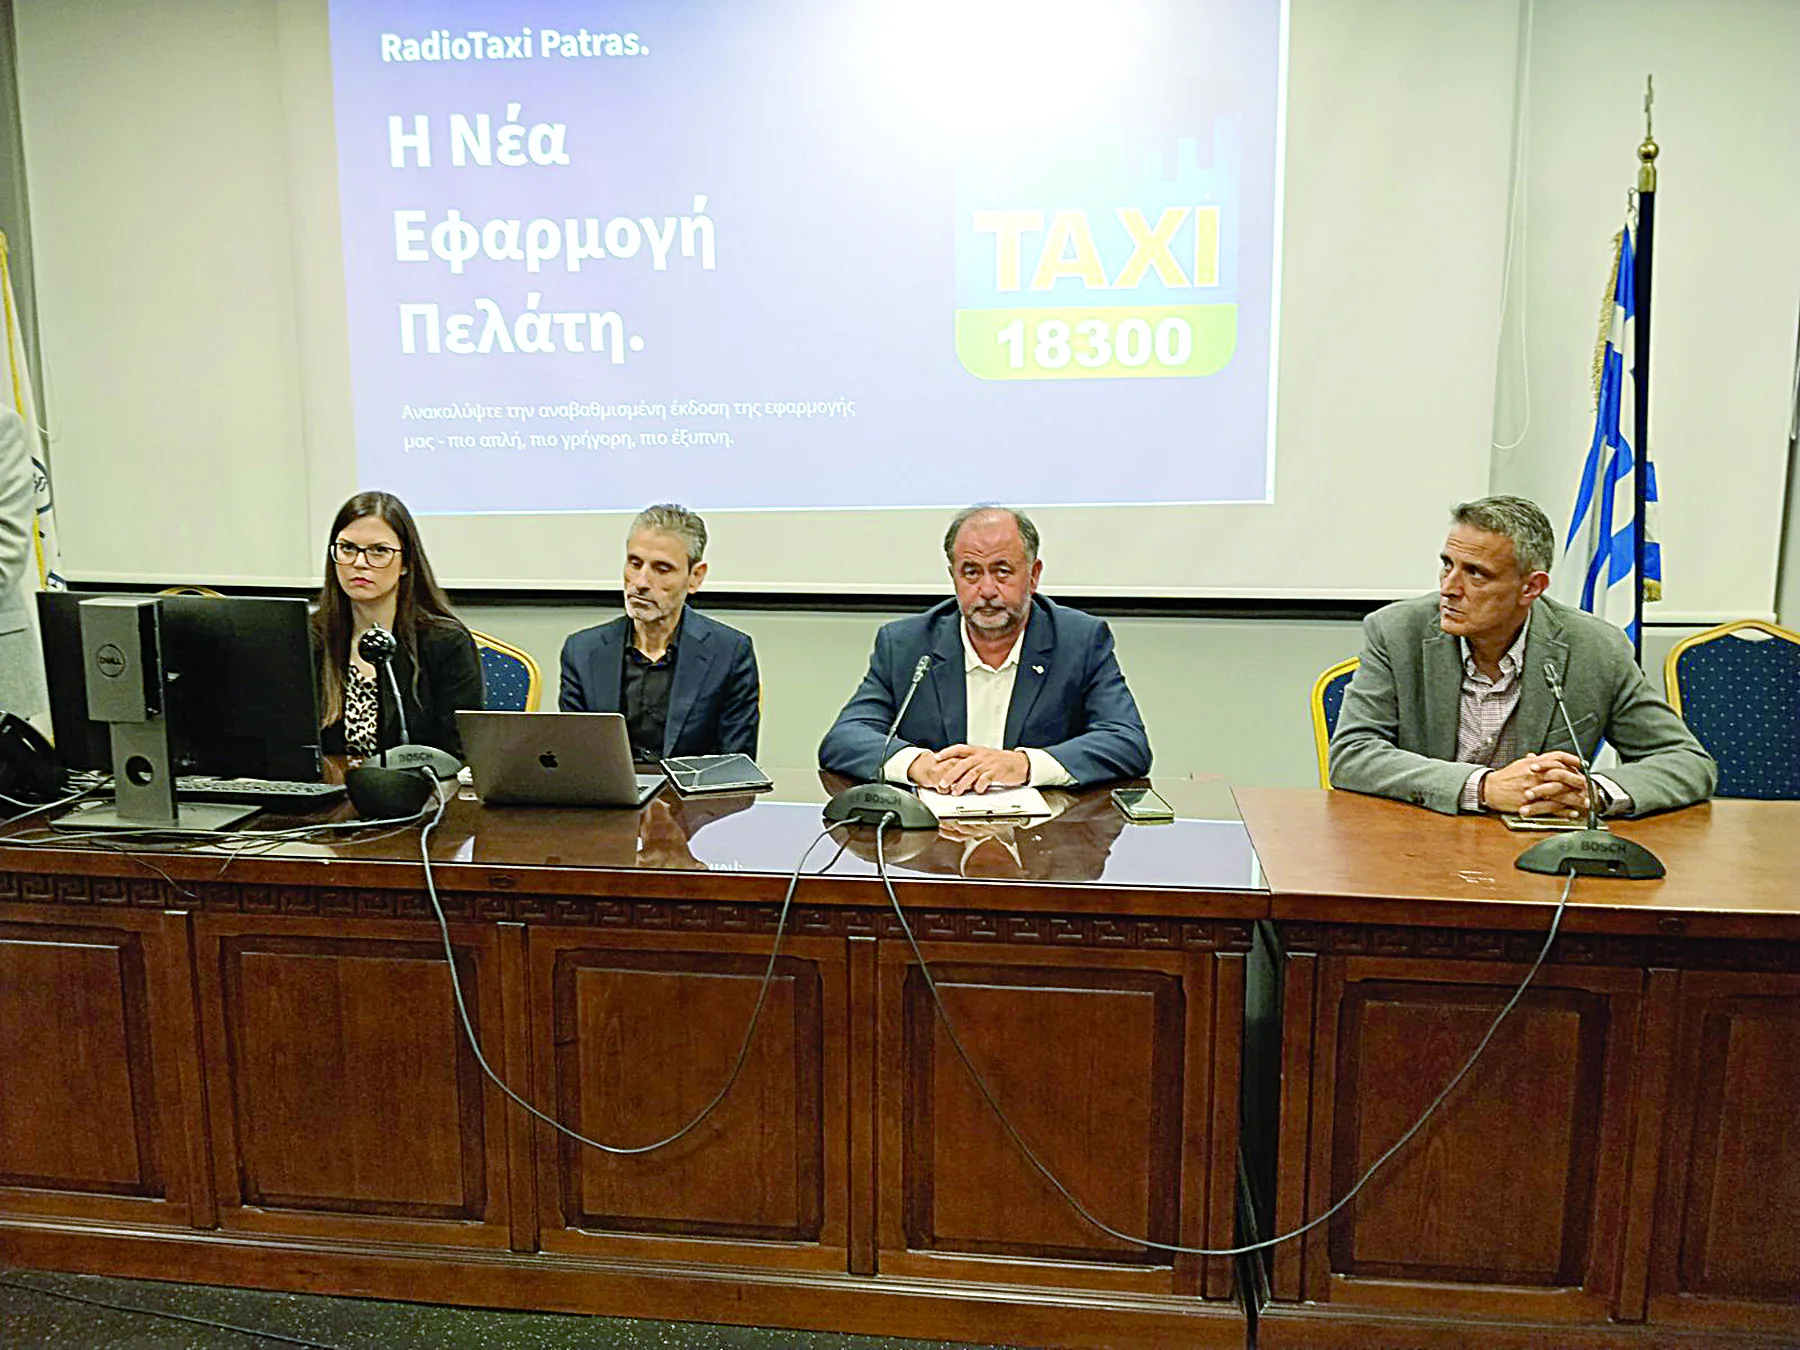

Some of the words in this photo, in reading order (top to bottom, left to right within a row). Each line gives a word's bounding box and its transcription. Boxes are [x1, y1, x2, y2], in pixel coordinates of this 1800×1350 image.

[381, 28, 533, 62] RadioTaxi
[540, 29, 650, 59] Patras.
[389, 115, 431, 168] Η
[450, 103, 570, 168] Νέα
[394, 194, 716, 274] Εφαρμογή
[973, 205, 1221, 292] TAXI
[399, 292, 645, 364] Πελάτη.
[997, 317, 1192, 369] 18300
[402, 402, 503, 422] Ανακαλύψτε
[506, 404, 534, 421] την
[538, 399, 667, 421] αναβαθμισμένη
[670, 398, 730, 419] έκδοση
[733, 400, 762, 419] της
[765, 396, 856, 418] εφαρμογής
[404, 435, 436, 452] μας
[447, 434, 477, 449] πιο
[479, 431, 526, 451] απλή,
[529, 433, 558, 447] πιο
[561, 430, 636, 450] γρήγορη,
[640, 431, 668, 446] πιο
[671, 428, 735, 448] έξυπνη.
[1581, 840, 1628, 853] BOSCH
